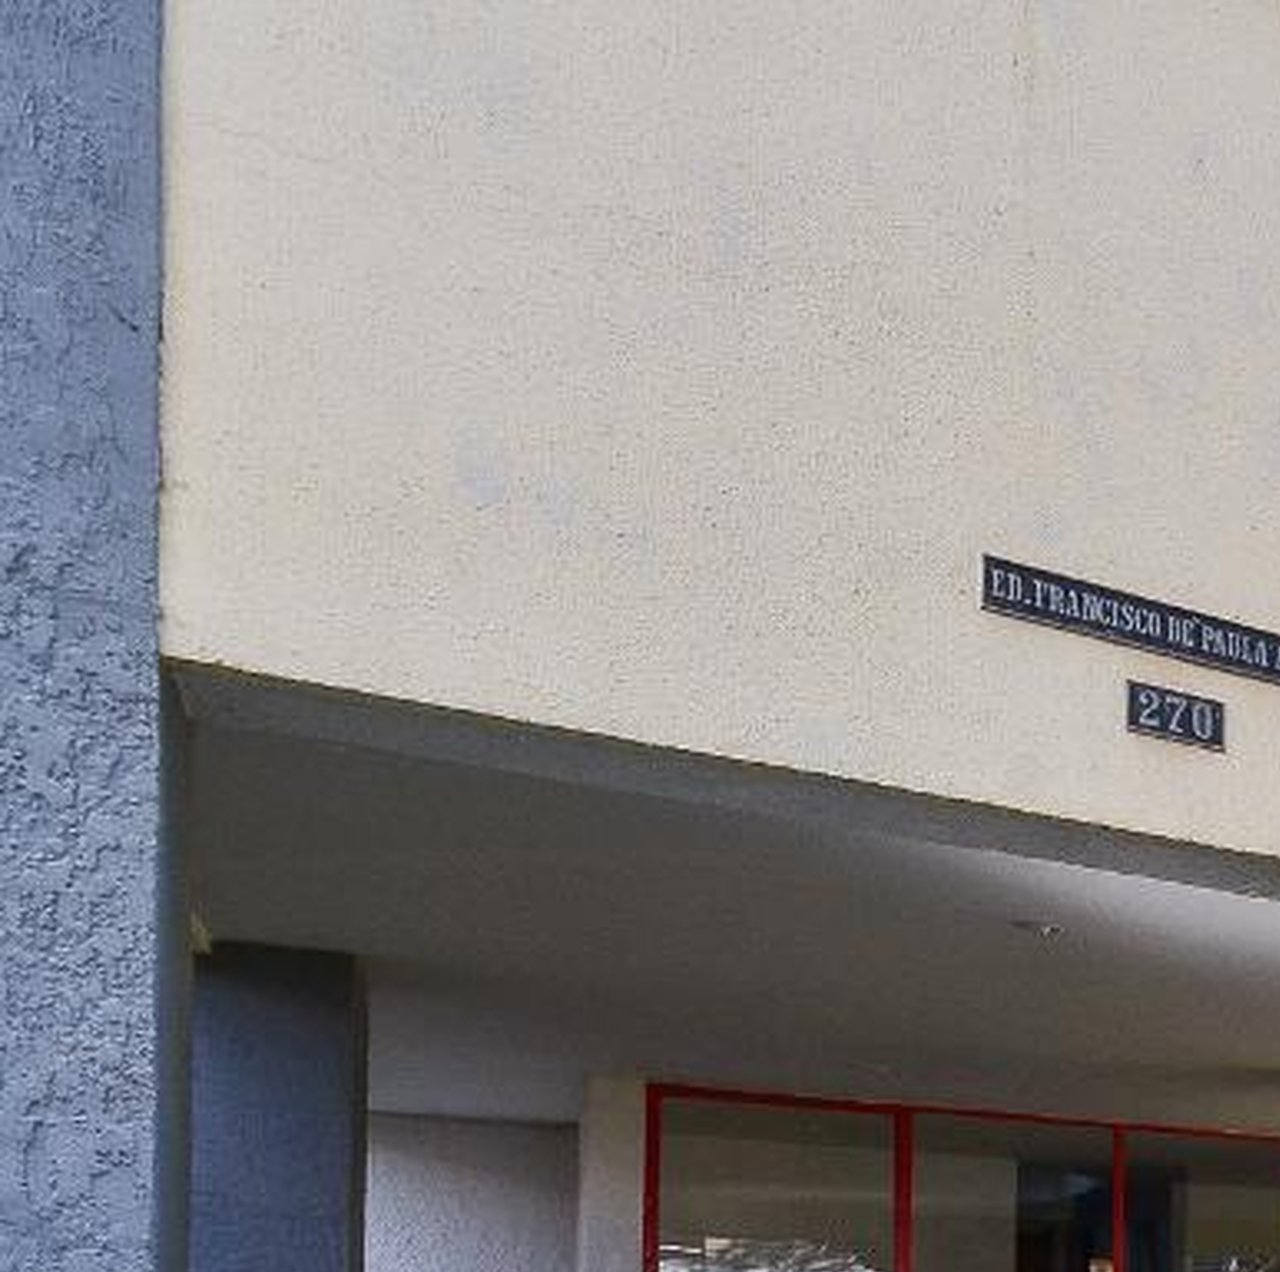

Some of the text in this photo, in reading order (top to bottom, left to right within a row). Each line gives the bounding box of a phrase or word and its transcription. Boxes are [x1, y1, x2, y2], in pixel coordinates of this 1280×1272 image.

[1167, 615, 1194, 648] DE
[1201, 624, 1267, 668] PAULA
[1137, 689, 1215, 740] 270
